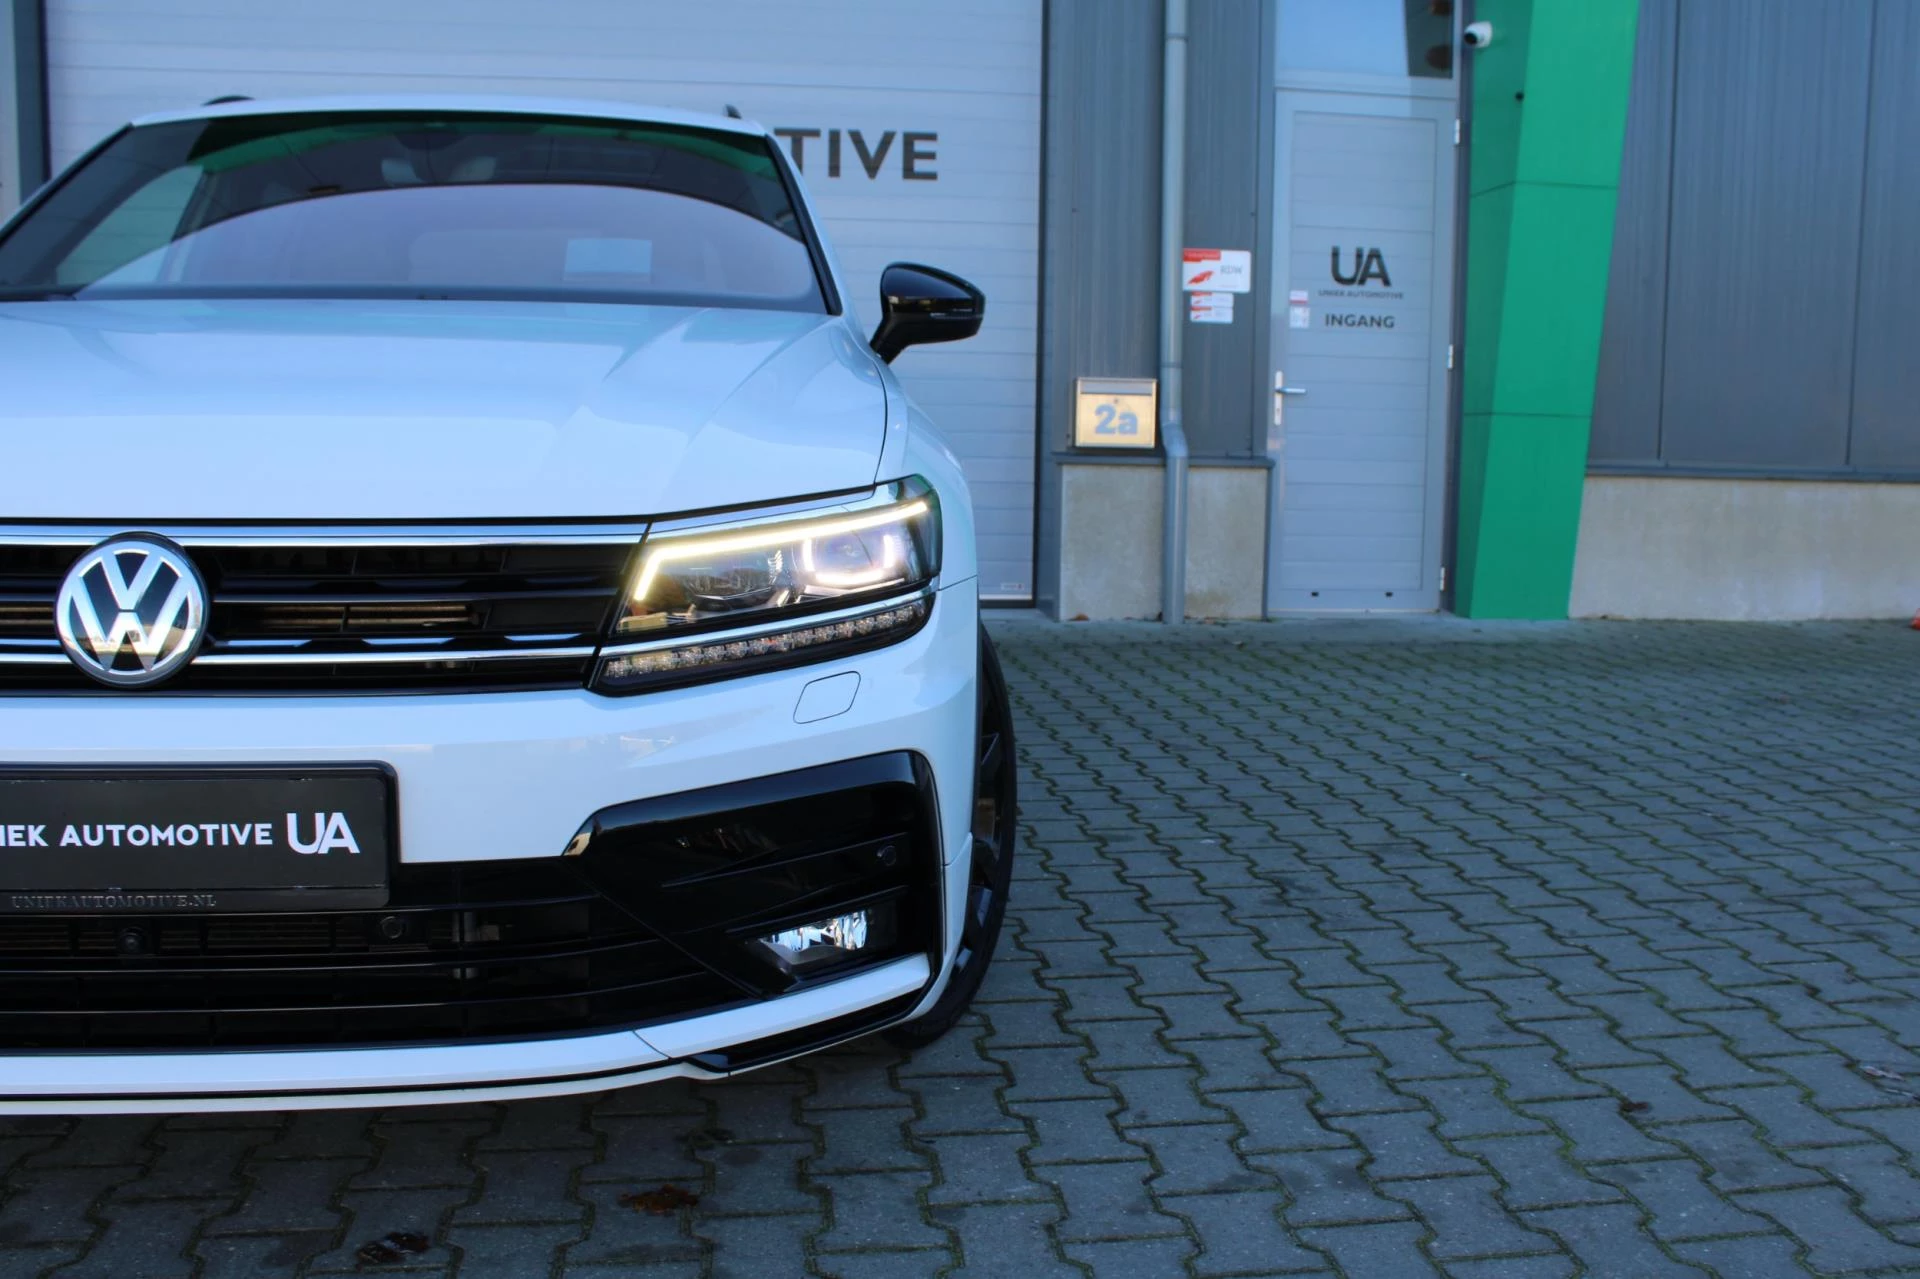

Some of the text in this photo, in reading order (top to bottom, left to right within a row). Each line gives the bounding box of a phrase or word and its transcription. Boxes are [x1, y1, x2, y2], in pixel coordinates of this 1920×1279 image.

[773, 127, 938, 181] TIVE
[1331, 246, 1391, 286] UA
[1346, 290, 1403, 300] AUTOMOTIVE
[1324, 312, 1395, 329] INGANG
[1094, 404, 1138, 435] 2a
[59, 823, 273, 847] AUTOMOTIVE
[286, 811, 360, 855] UA
